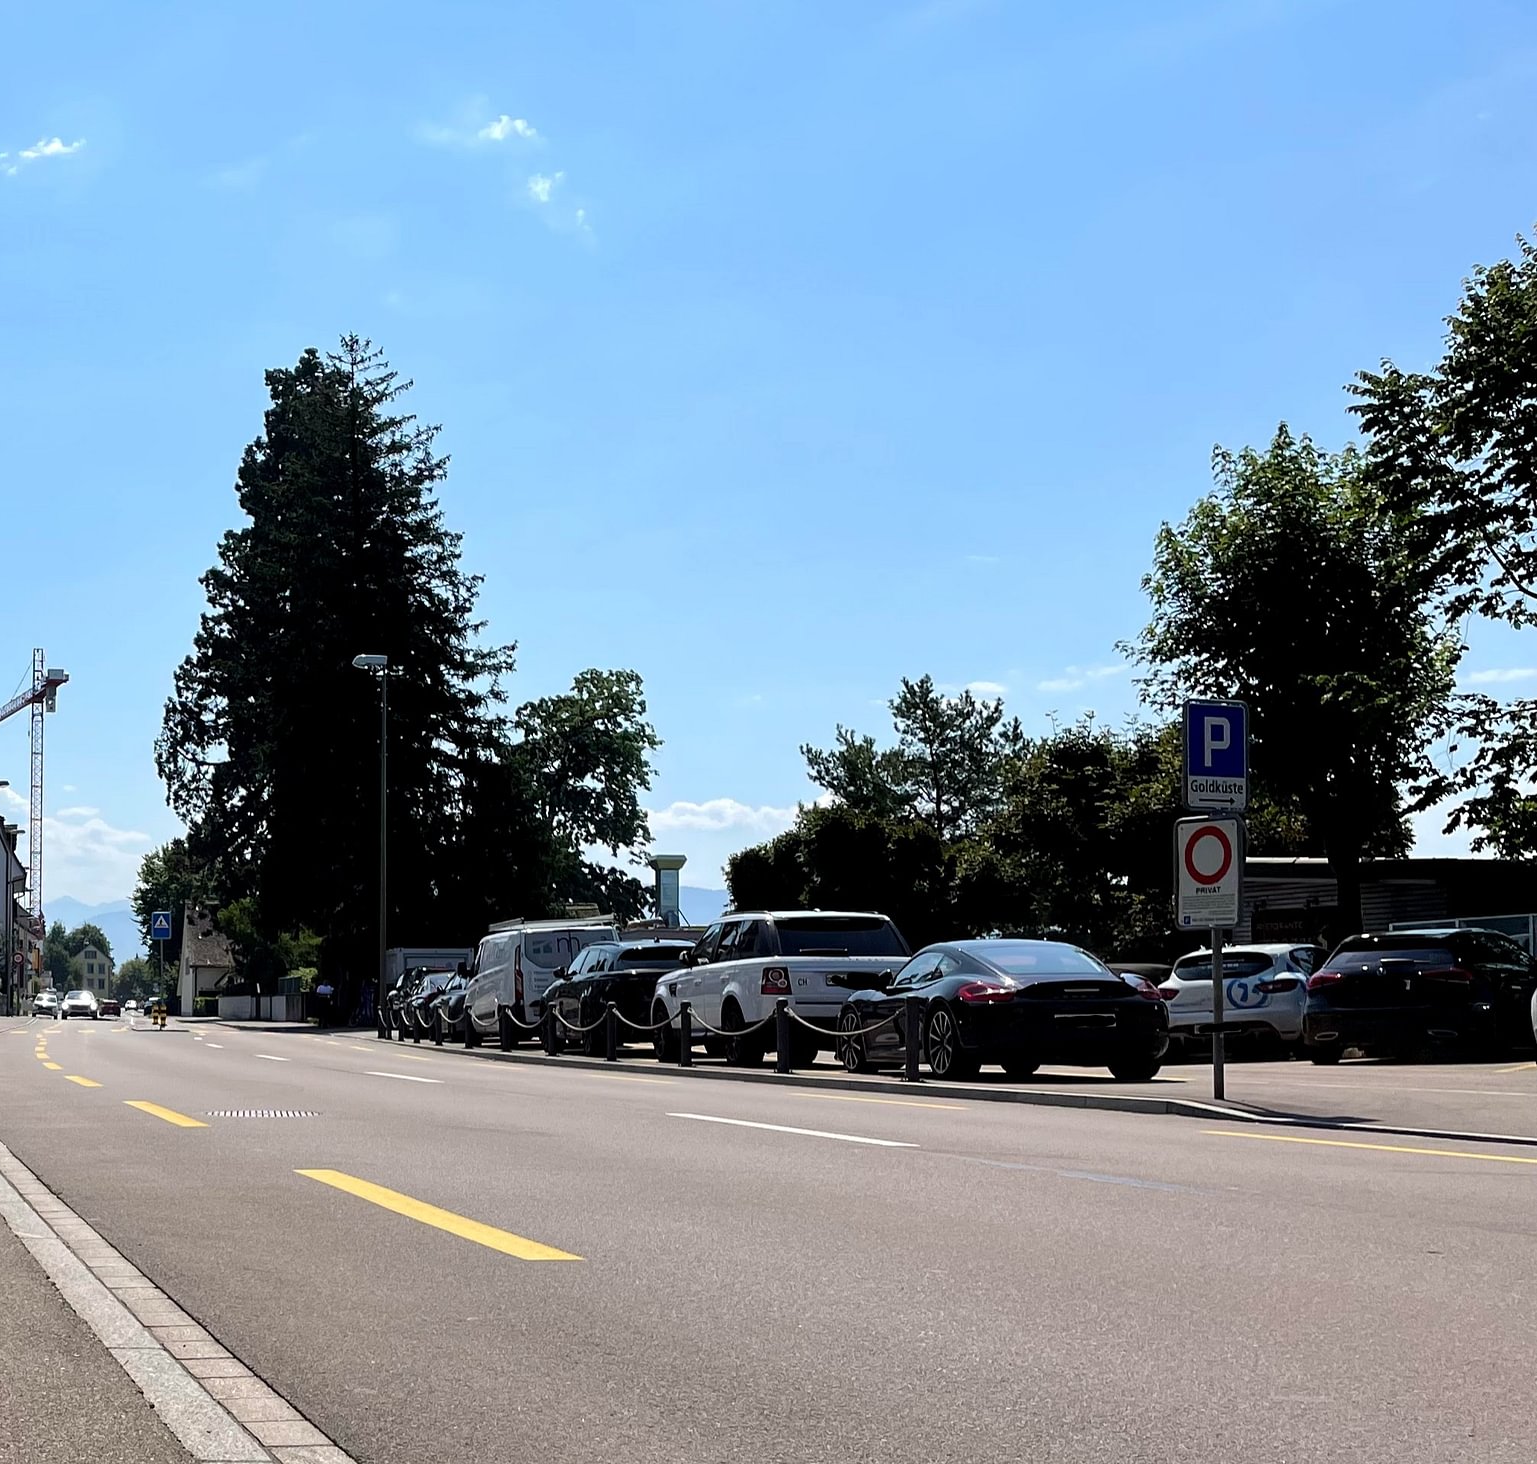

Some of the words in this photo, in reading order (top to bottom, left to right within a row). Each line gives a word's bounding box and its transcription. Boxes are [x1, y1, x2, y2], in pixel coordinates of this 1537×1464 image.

[1204, 716, 1231, 767] P
[1190, 780, 1244, 794] Goldküste
[1195, 886, 1221, 895] PRIVAT
[797, 978, 808, 986] CH
